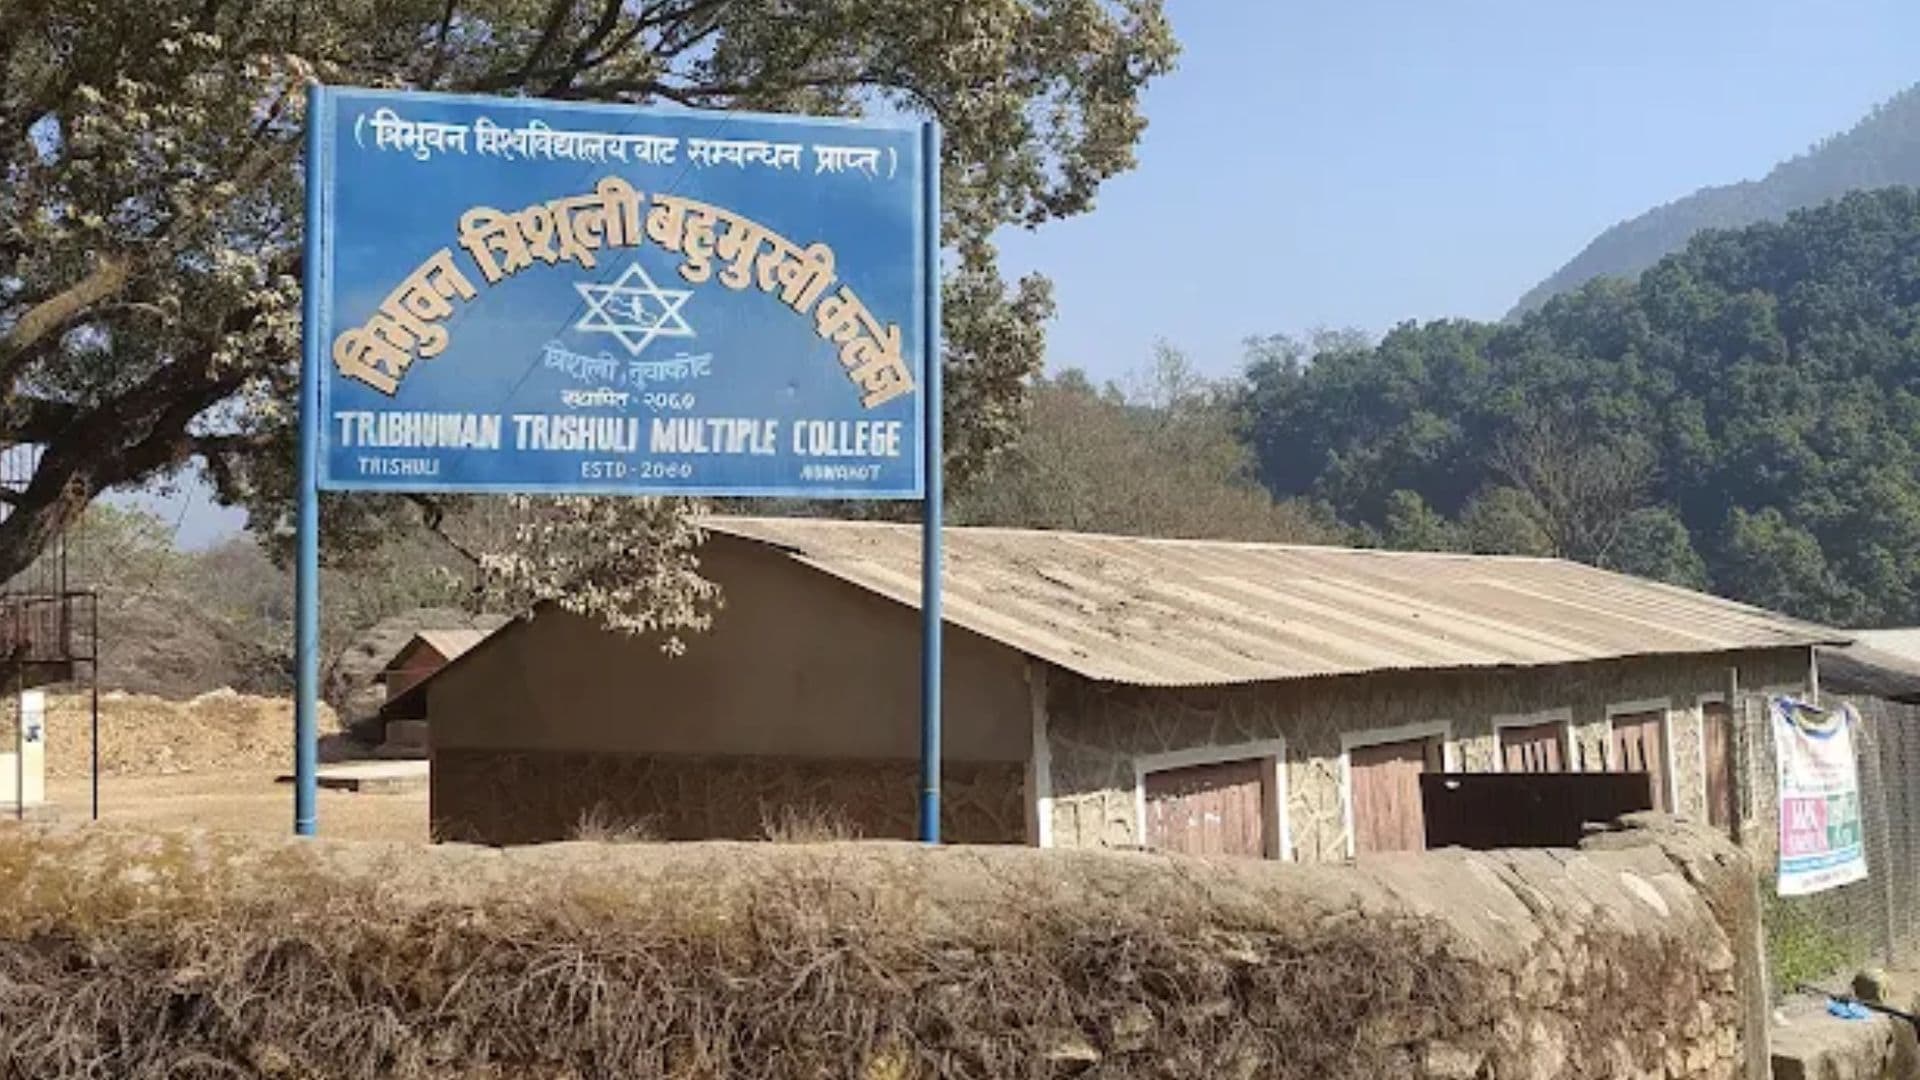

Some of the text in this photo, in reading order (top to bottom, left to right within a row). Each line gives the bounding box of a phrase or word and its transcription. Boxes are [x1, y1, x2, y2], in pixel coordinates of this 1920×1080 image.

[333, 247, 478, 398] त्रिभुवन
[646, 194, 838, 314] बहुमुखी
[814, 283, 915, 409] कलेज
[334, 411, 902, 457] TRIBHUWAN TRISHULI MULTIPLE COLLEGE
[358, 457, 439, 475] TRISHULI
